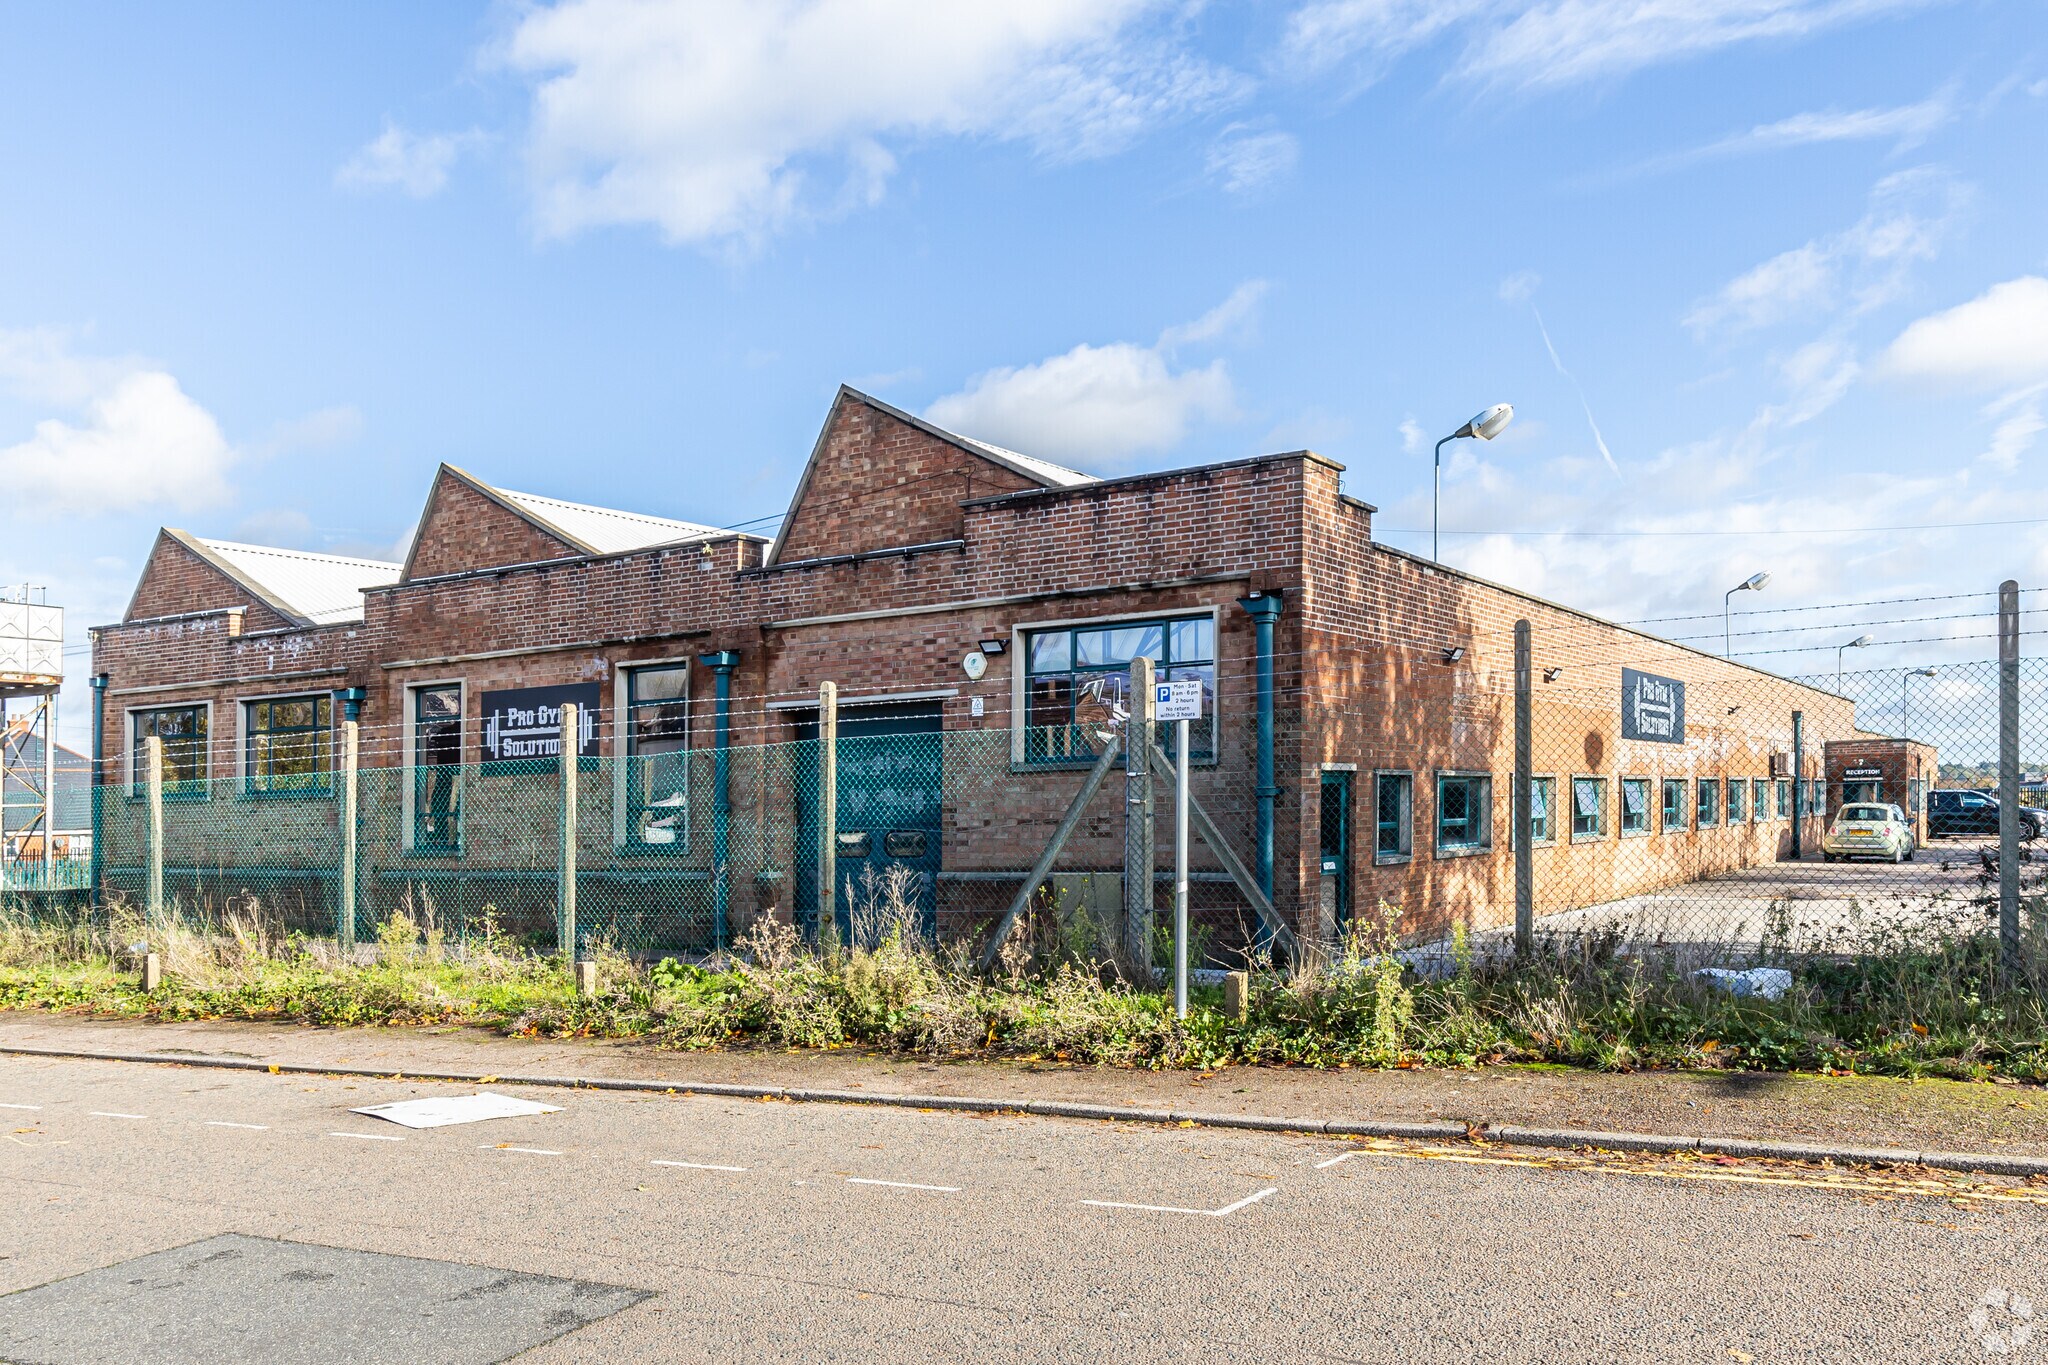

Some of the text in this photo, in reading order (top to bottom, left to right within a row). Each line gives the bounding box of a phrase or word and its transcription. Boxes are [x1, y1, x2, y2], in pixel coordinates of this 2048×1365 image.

[1160, 688, 1169, 701] P
[508, 705, 560, 727] PRO GY
[503, 738, 560, 757] SOLUTIO
